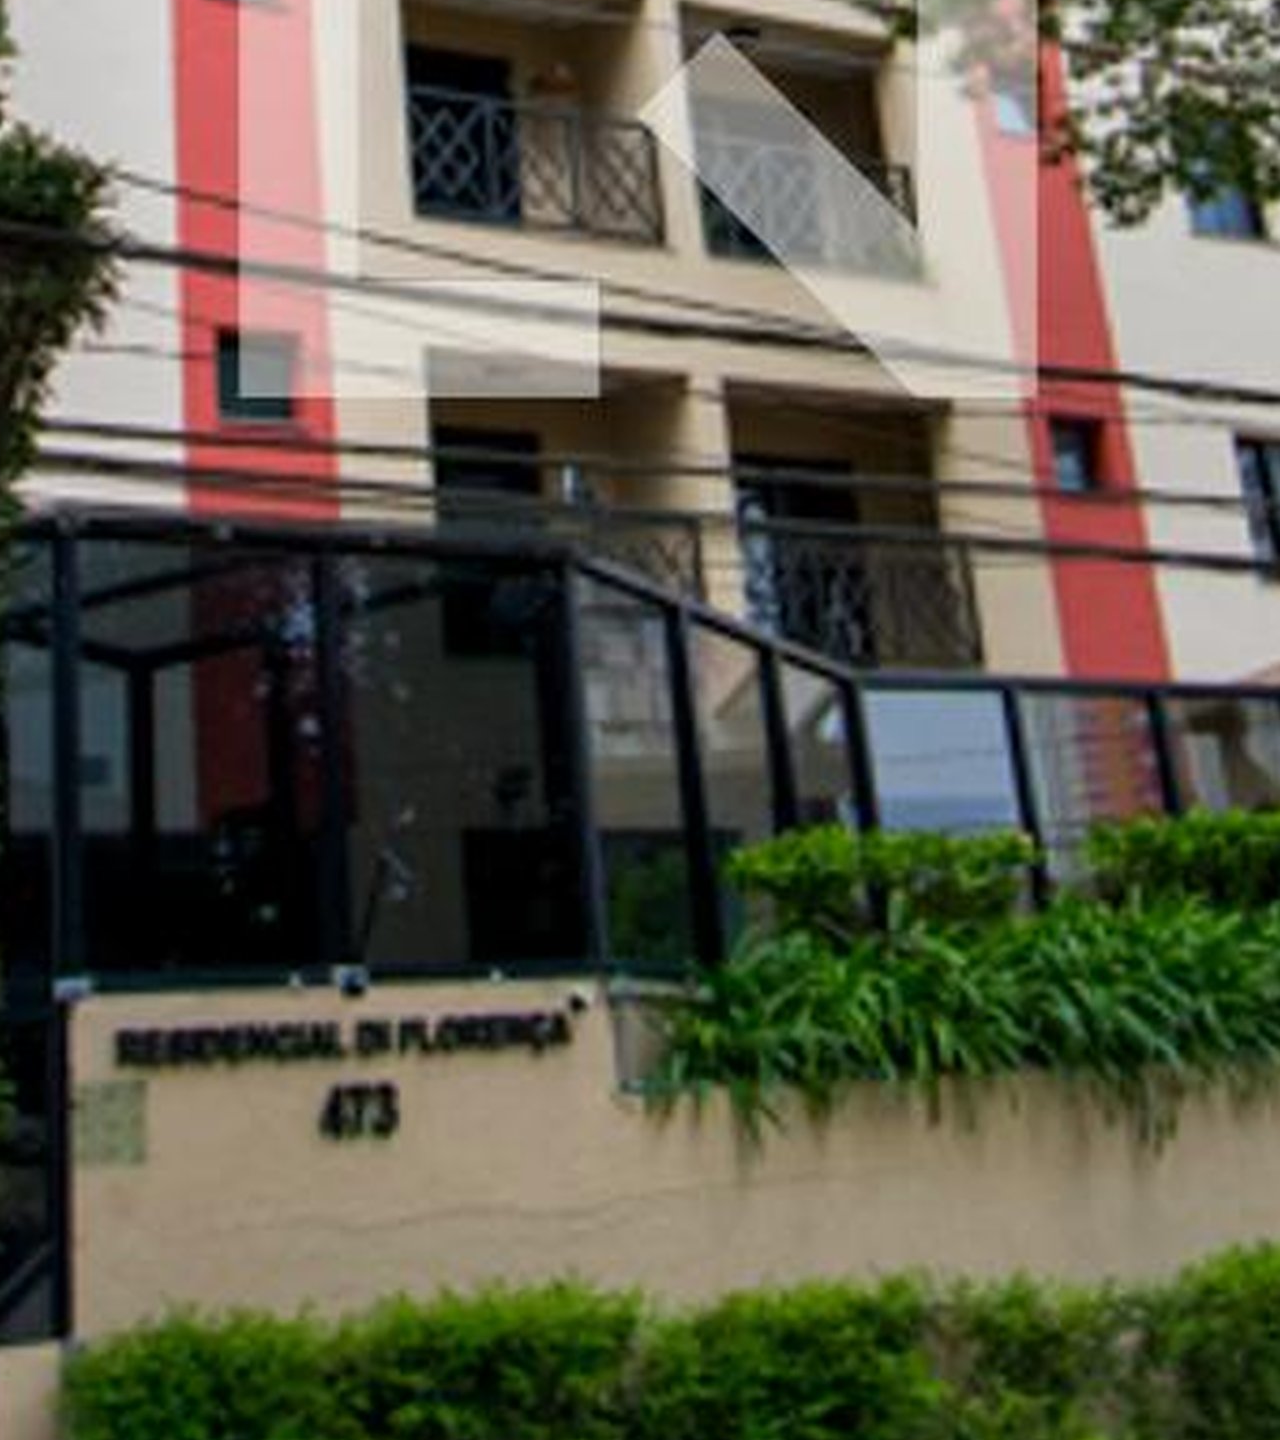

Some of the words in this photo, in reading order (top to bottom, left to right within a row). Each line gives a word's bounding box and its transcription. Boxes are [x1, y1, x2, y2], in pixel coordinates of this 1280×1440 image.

[115, 1022, 342, 1068] RESIDENCIAL
[357, 1018, 390, 1056] DI
[400, 1009, 571, 1058] FLORENÇA
[320, 1084, 400, 1140] 473
